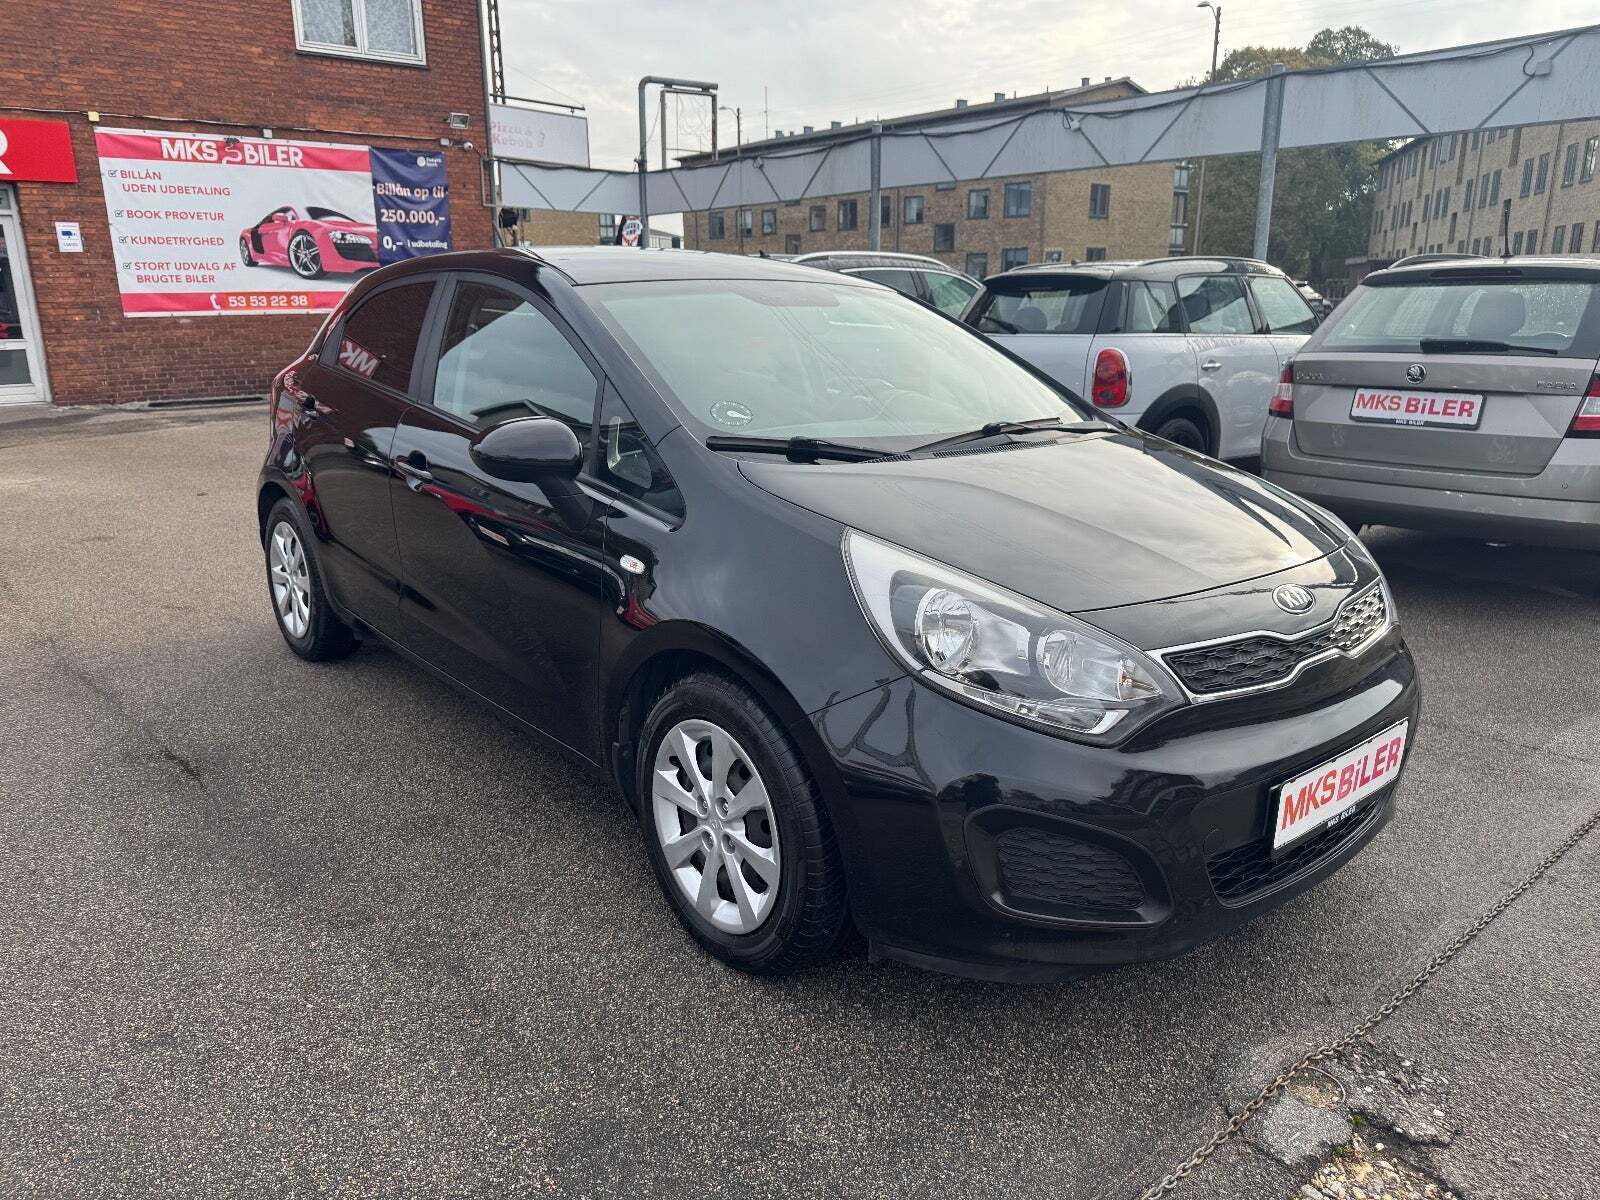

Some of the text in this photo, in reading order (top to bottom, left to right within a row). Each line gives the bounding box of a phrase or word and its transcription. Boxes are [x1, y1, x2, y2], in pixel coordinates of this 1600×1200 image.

[160, 138, 304, 167] MKS BILER
[120, 169, 161, 180] BILLÅN
[122, 183, 230, 196] UDEN UDBETALING
[414, 187, 429, 200] op
[432, 185, 445, 198] til
[126, 209, 224, 221] BOOK PRØVETUR
[380, 208, 446, 226] 250.000,-
[131, 236, 224, 246] KUNDETRYGHED
[382, 235, 403, 252] 0,-
[411, 240, 449, 250] udbetaling
[134, 262, 237, 271] STORT UDVALG AF
[136, 274, 215, 284] BRUGTE BILER
[228, 295, 308, 307] 53 53 22 38
[1355, 393, 1402, 411] MKS
[1281, 768, 1337, 831] MKS
